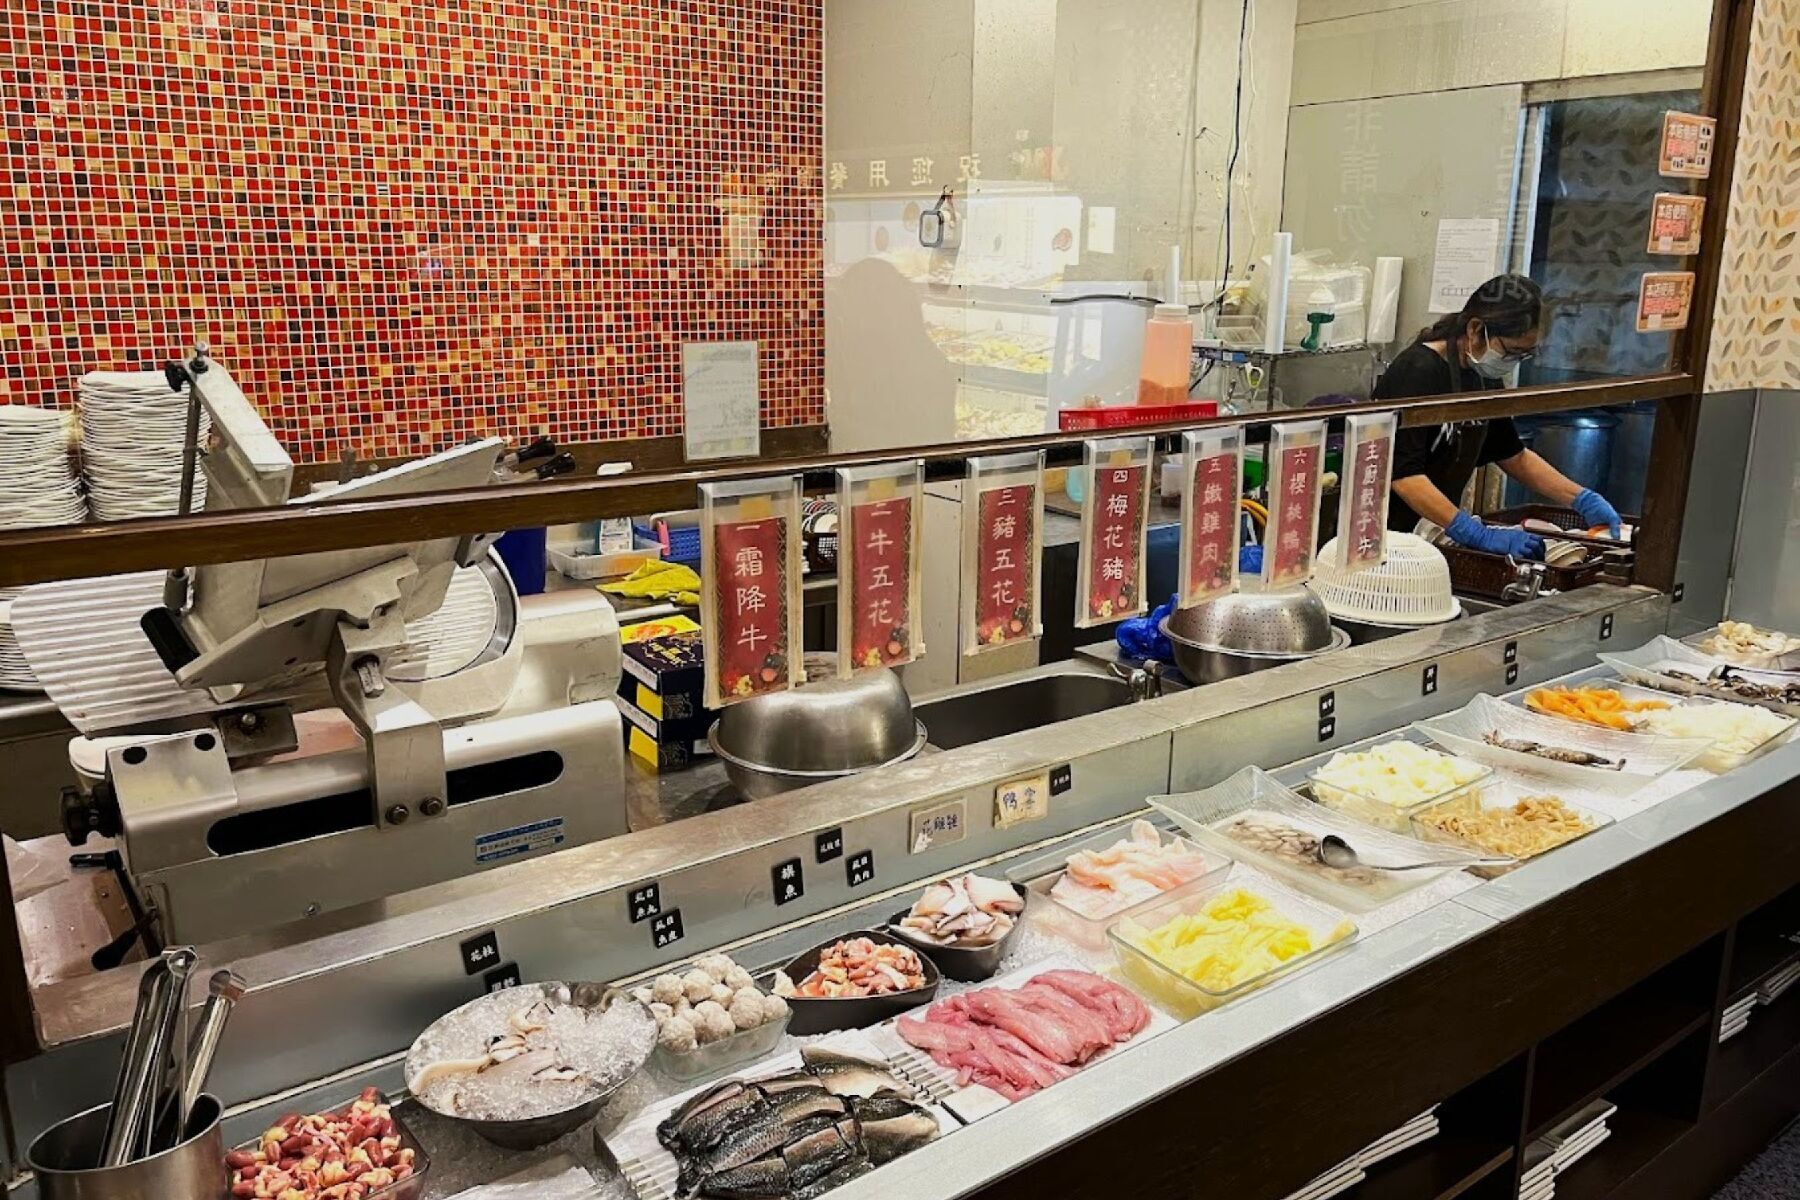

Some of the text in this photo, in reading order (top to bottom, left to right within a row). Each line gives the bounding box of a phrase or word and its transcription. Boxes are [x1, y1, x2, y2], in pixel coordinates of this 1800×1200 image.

[866, 502, 895, 627] 二牛五花
[991, 488, 1016, 607] 三豬五花
[1102, 469, 1129, 582] 四梅花豬
[734, 523, 767, 652] 一霜降牛
